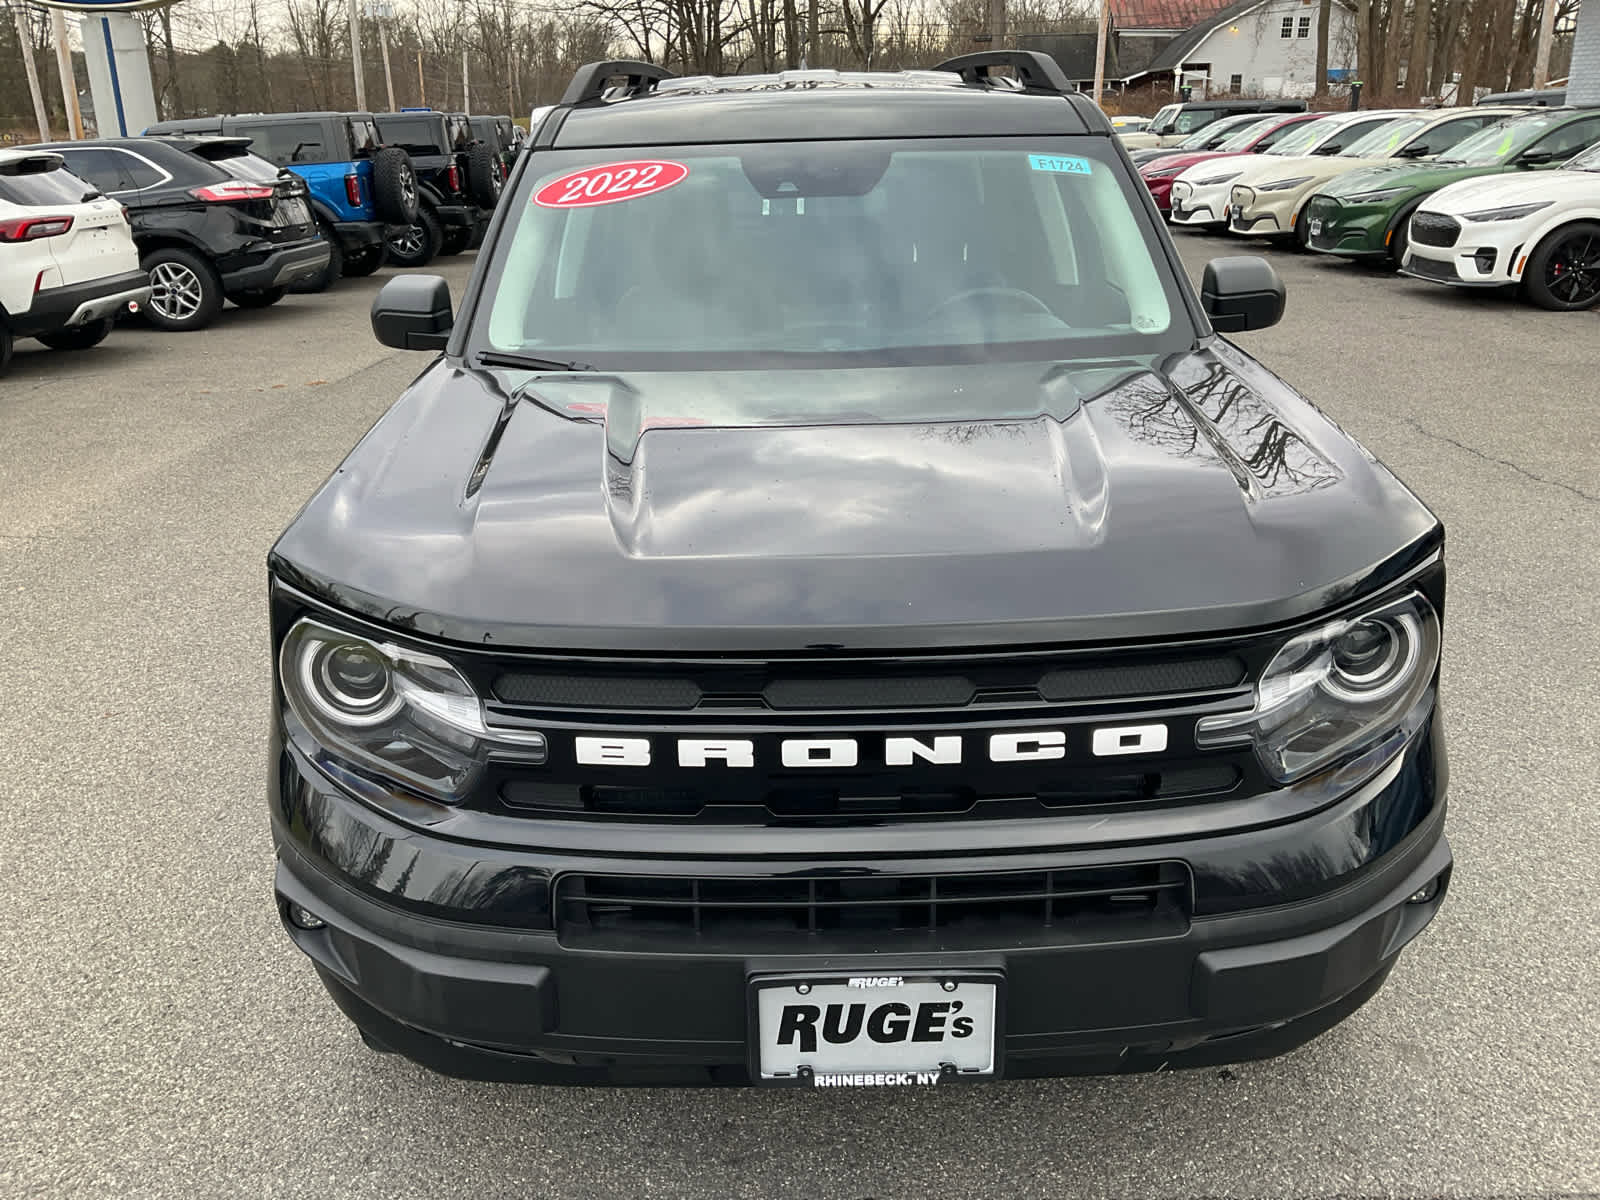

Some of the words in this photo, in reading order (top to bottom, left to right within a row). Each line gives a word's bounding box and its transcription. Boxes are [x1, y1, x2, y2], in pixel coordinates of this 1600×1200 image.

[557, 164, 663, 203] 2022
[575, 724, 1168, 767] BRONCO
[776, 1000, 974, 1052] RUGE's
[917, 1073, 940, 1085] NY
